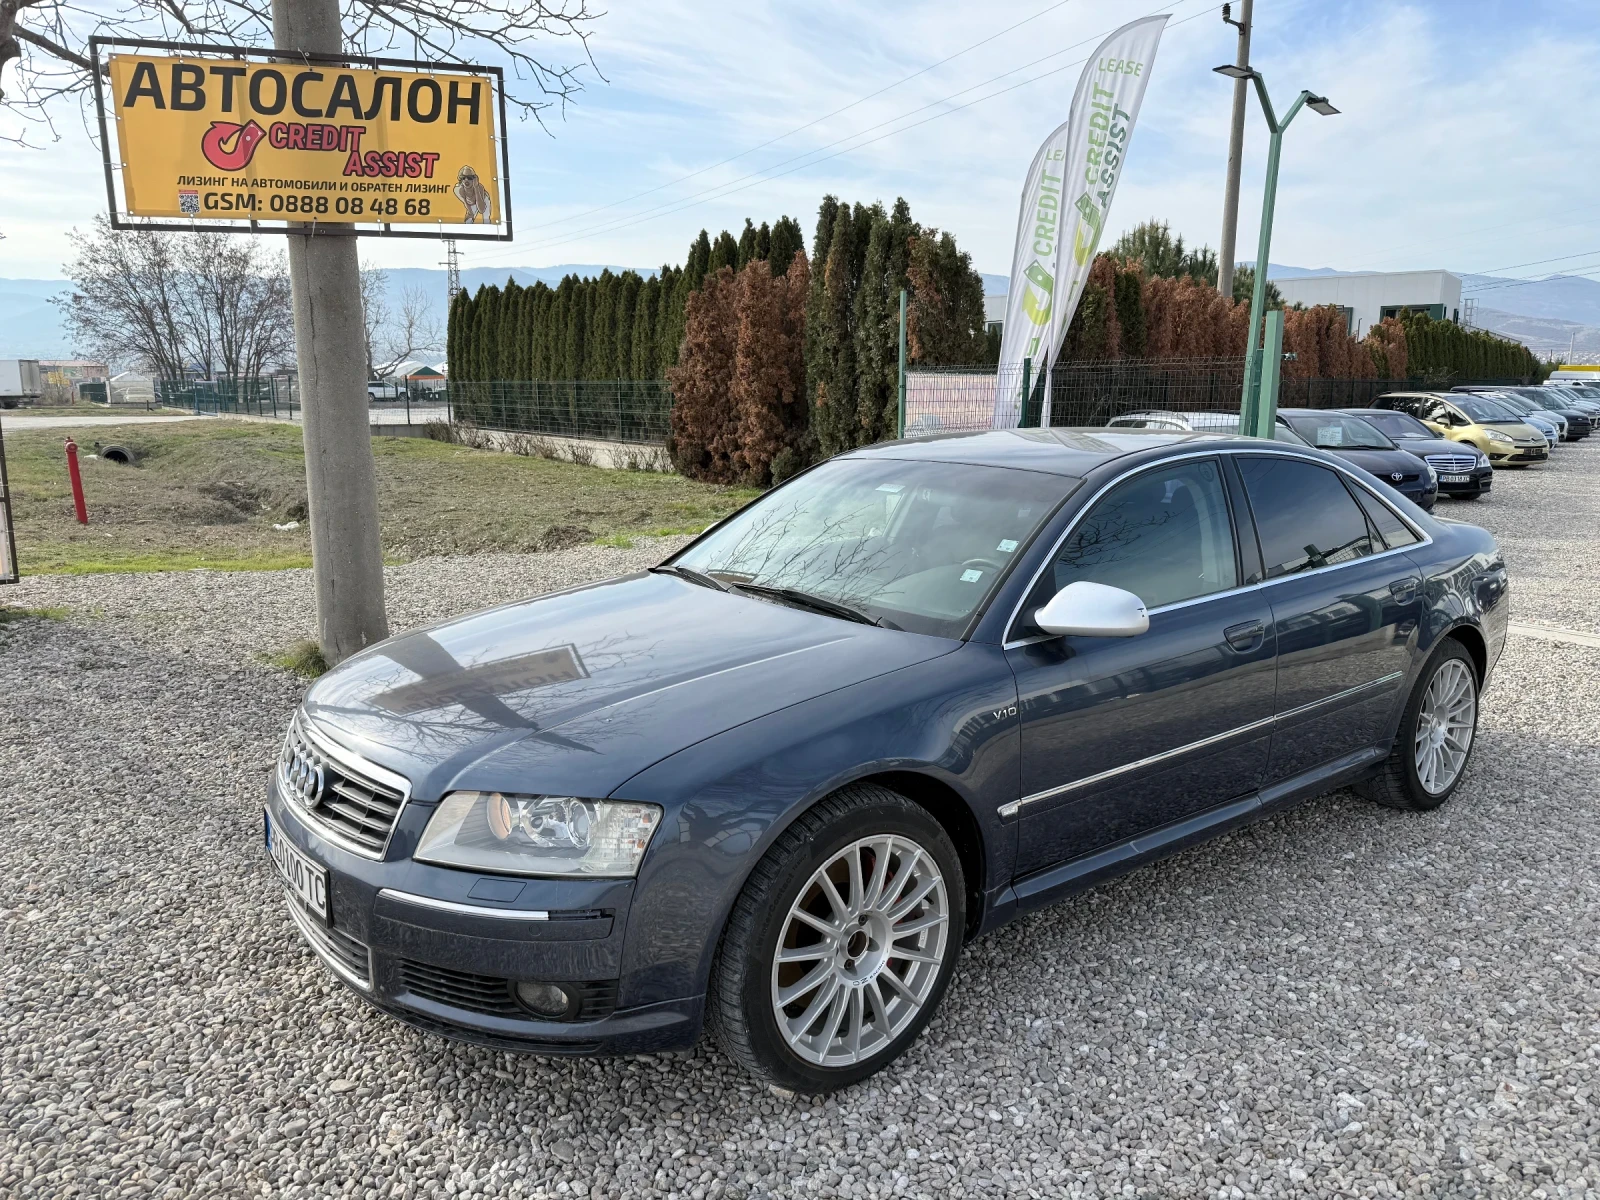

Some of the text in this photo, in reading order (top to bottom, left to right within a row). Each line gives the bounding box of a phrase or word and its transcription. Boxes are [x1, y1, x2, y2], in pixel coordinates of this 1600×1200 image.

[1098, 58, 1143, 77] LEASE
[123, 61, 481, 125] АВТОСАЛОН
[269, 122, 366, 152] CREDIT
[1085, 82, 1114, 185] CREDIT
[343, 150, 440, 178] ASSIST
[1097, 103, 1131, 209] ASSIST
[177, 175, 451, 194] ЛИЗИНГ НА АВТОМОБИЛИ И ОБРАТЕН ЛИЗИНГ
[204, 192, 431, 216] GSM: 0888 08 48 68
[1032, 169, 1061, 257] CREDIT
[993, 707, 1016, 719] V10
